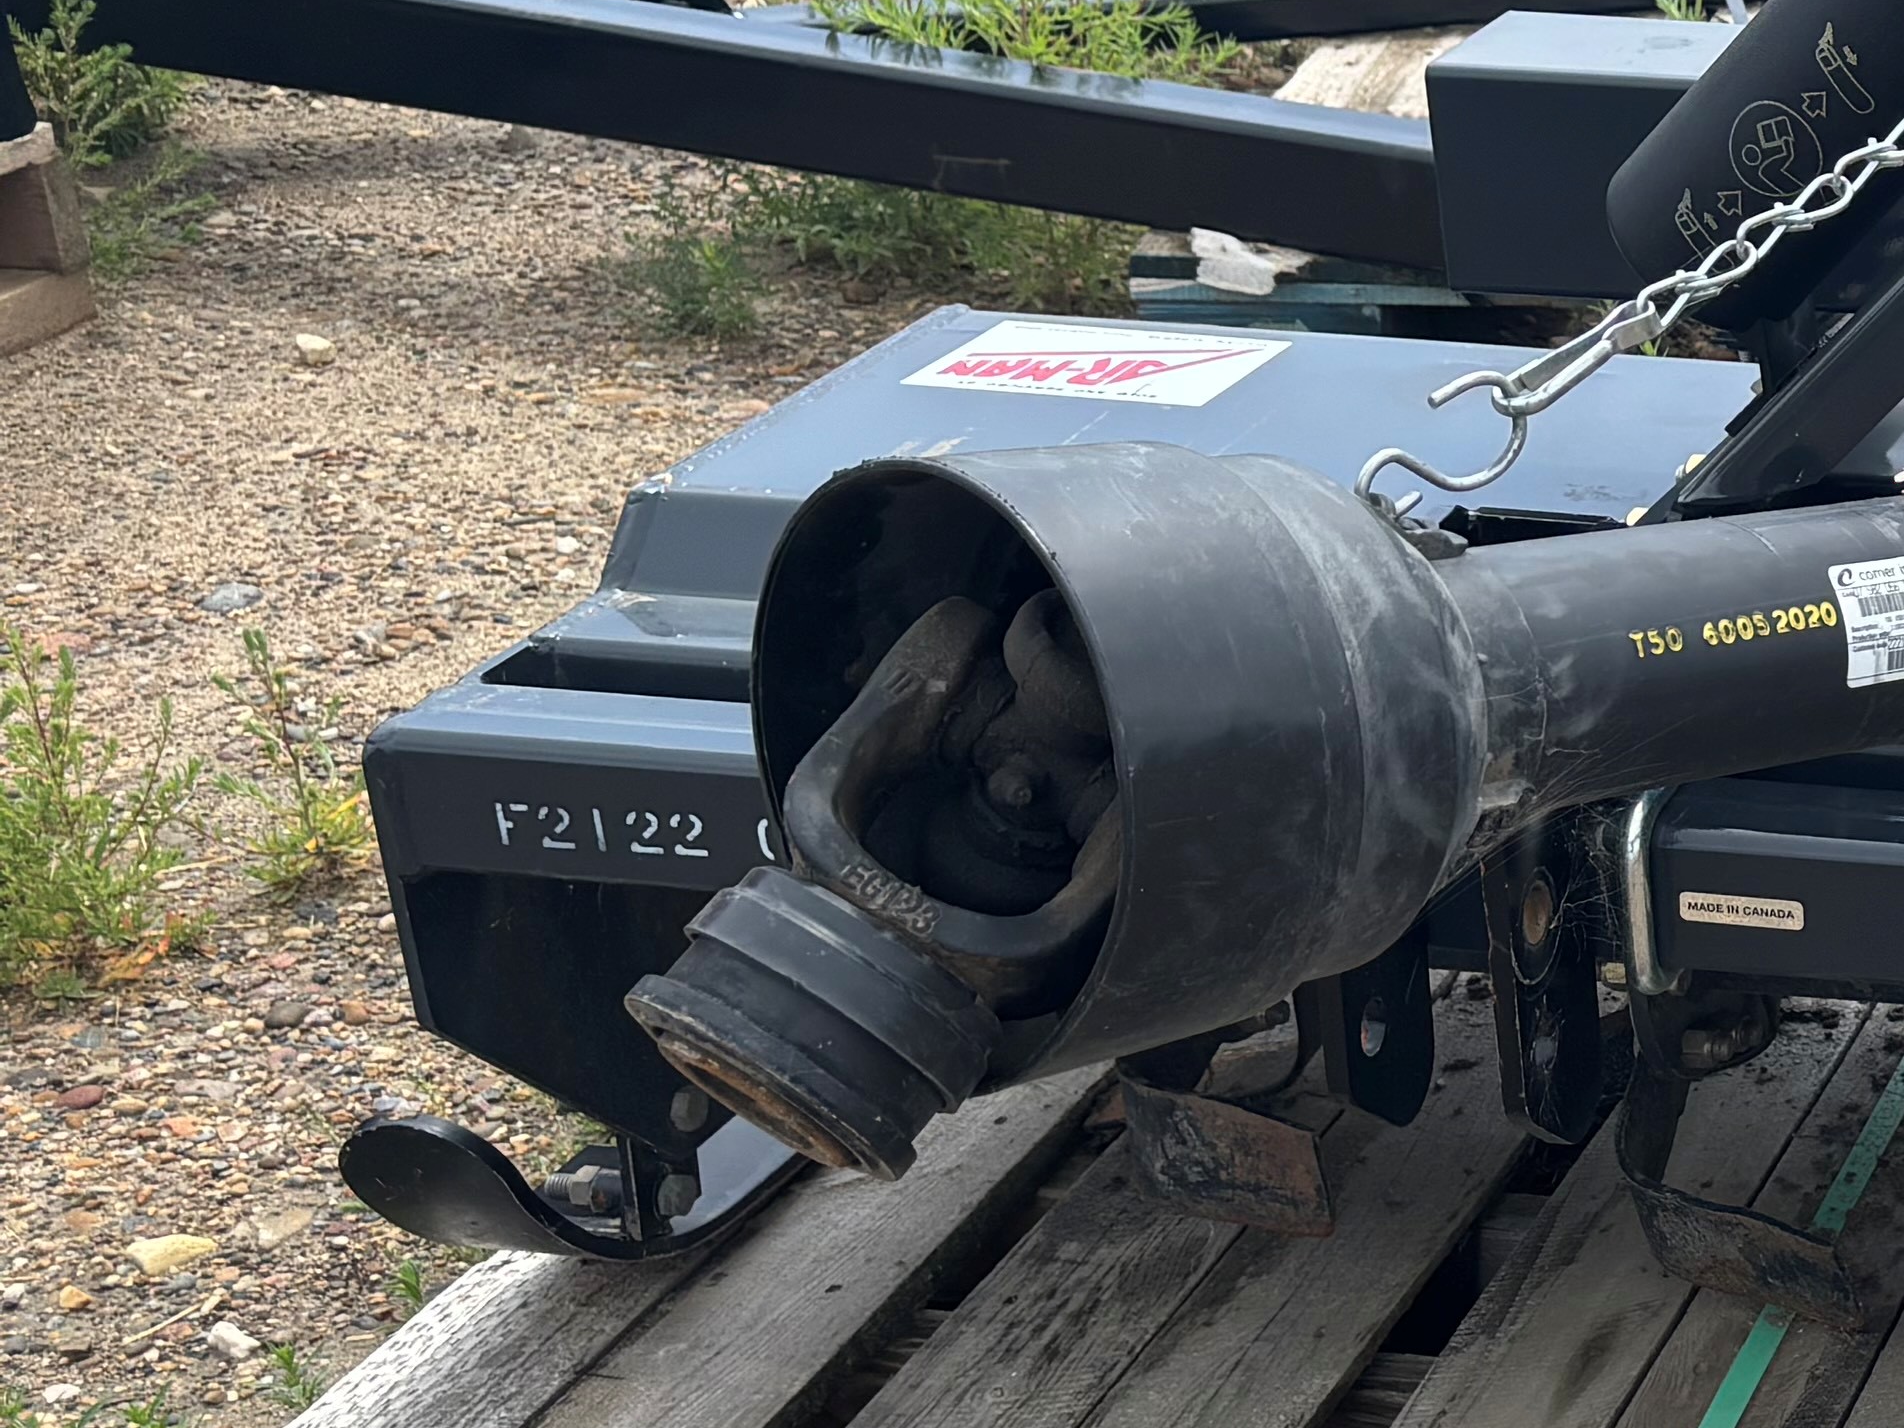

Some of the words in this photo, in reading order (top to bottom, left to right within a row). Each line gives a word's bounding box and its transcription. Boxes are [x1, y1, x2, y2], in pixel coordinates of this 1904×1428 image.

[1628, 625, 1683, 658] T50
[494, 802, 709, 858] F2122
[1687, 901, 1724, 914] MADE
[1727, 904, 1739, 915] IN
[1742, 906, 1795, 920] CANADA
